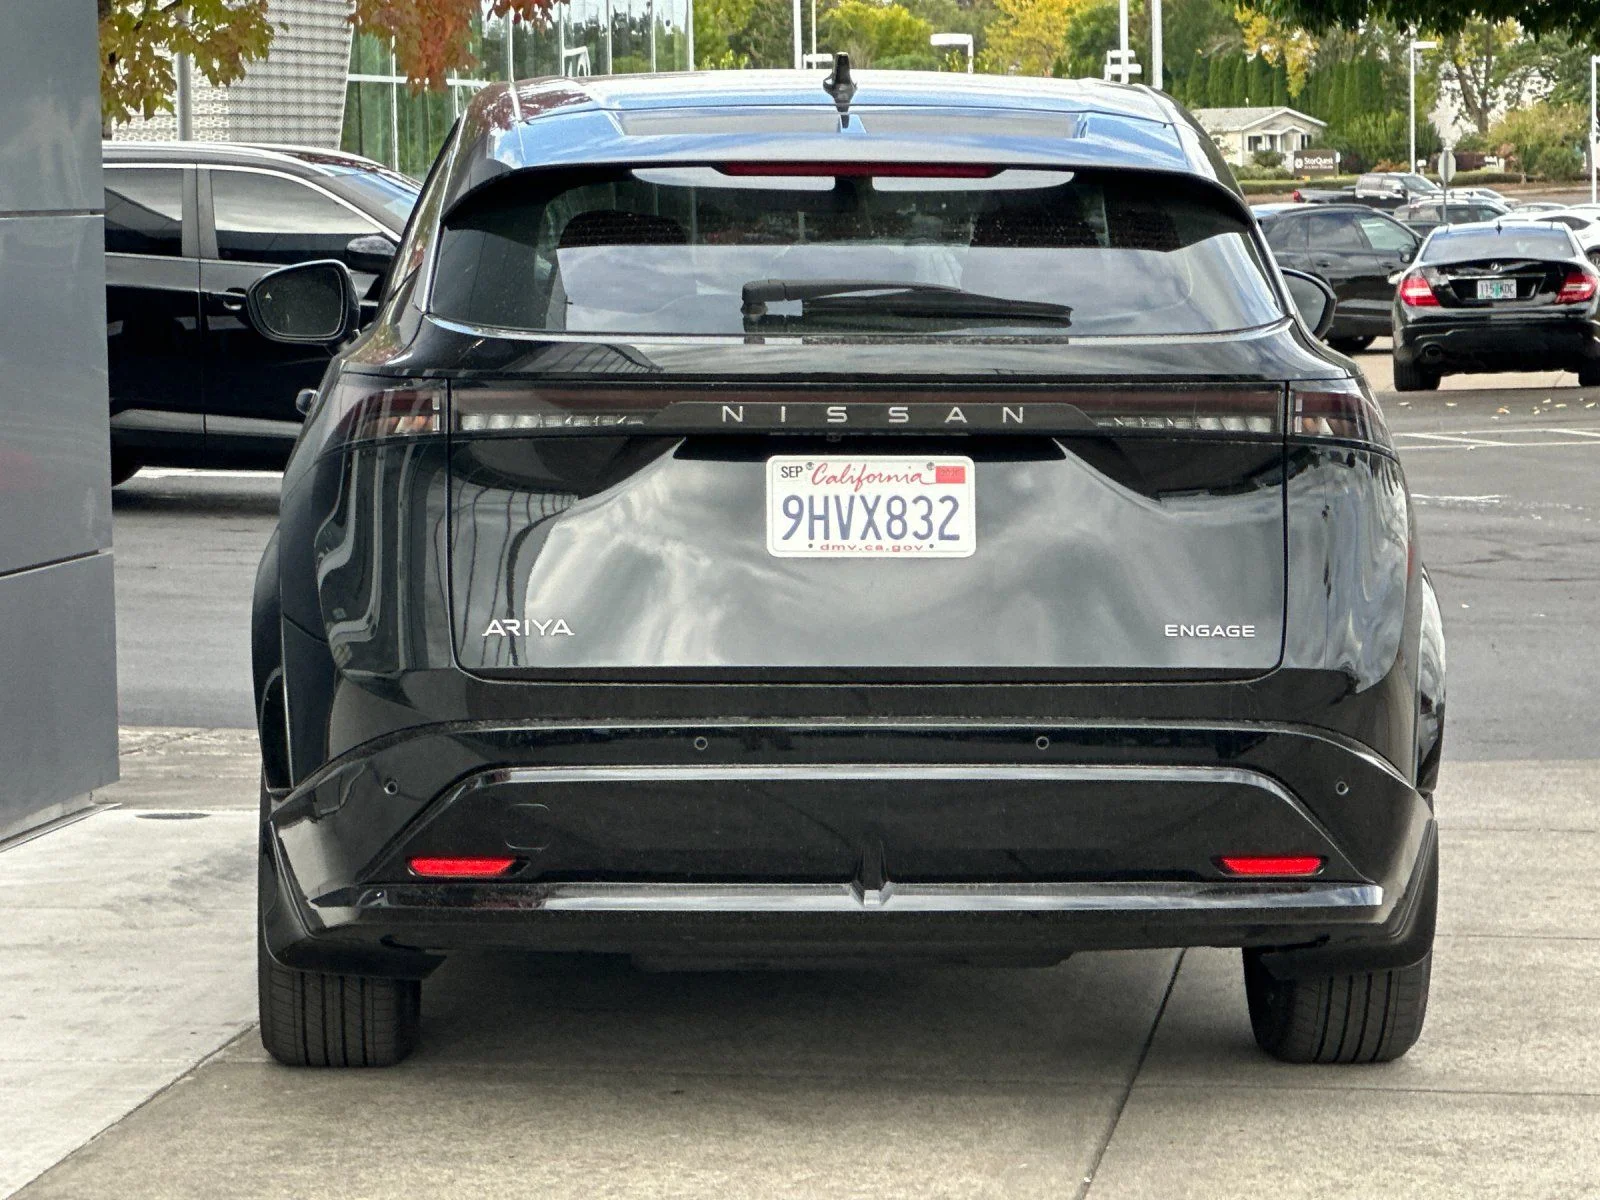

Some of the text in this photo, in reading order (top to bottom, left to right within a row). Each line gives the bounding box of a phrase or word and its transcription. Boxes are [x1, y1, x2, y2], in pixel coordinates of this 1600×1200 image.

[722, 405, 1024, 423] NISSAN
[781, 462, 937, 492] SEP California
[781, 494, 960, 541] 9HVX832
[819, 543, 924, 553] dmv.ca.gov
[481, 618, 575, 637] ARIYA
[1164, 624, 1255, 638] ENGAGE
